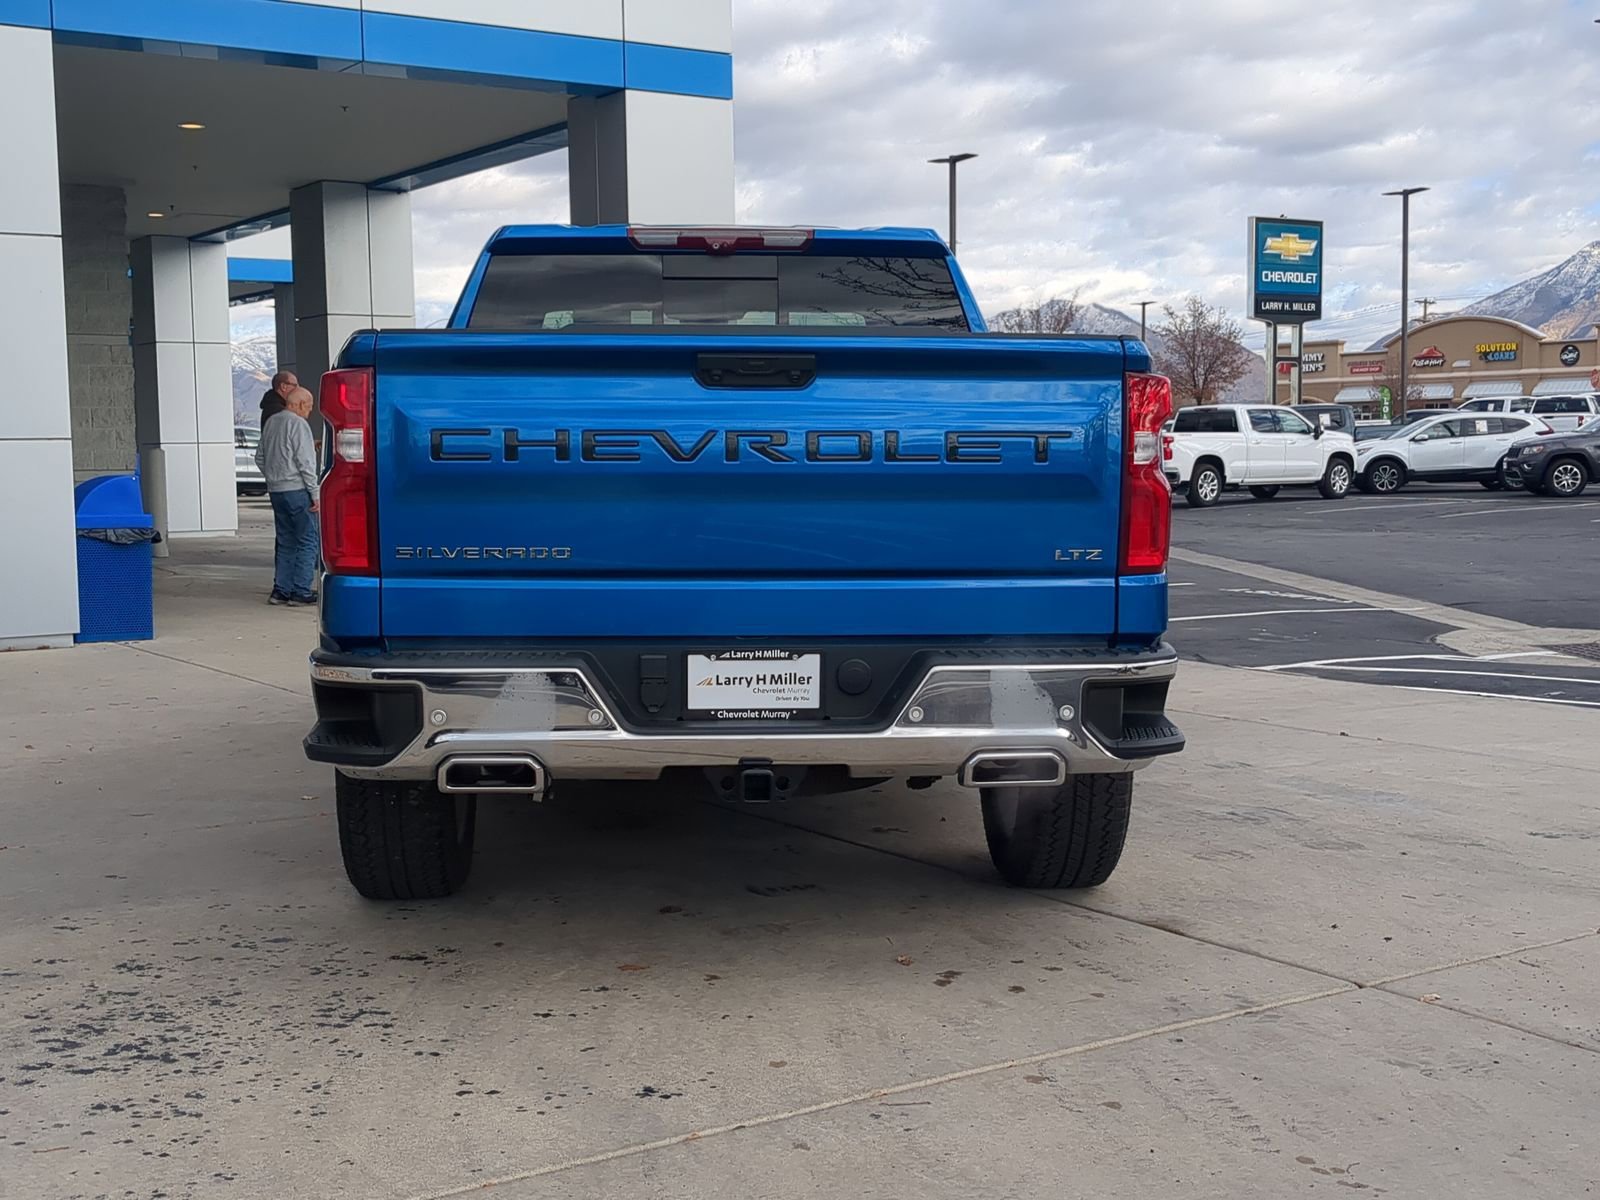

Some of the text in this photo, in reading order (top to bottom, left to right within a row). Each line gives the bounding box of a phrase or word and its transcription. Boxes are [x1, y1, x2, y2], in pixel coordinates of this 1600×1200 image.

[1262, 270, 1318, 284] CHEVROLET
[1261, 301, 1316, 312] LARRY H. MILLER
[1475, 343, 1517, 352] SOLUTION
[1302, 352, 1323, 362] MMY
[1489, 351, 1516, 361] LOANS
[1302, 363, 1324, 372] HN'S
[430, 428, 1073, 464] CHEVROLET
[395, 547, 571, 559] SILVERADO
[1055, 549, 1103, 561] LTZ
[731, 651, 755, 660] Larry
[763, 650, 789, 659] Miller
[716, 672, 813, 688] Larry H Miller
[717, 710, 791, 720] Chevrolet Murray
